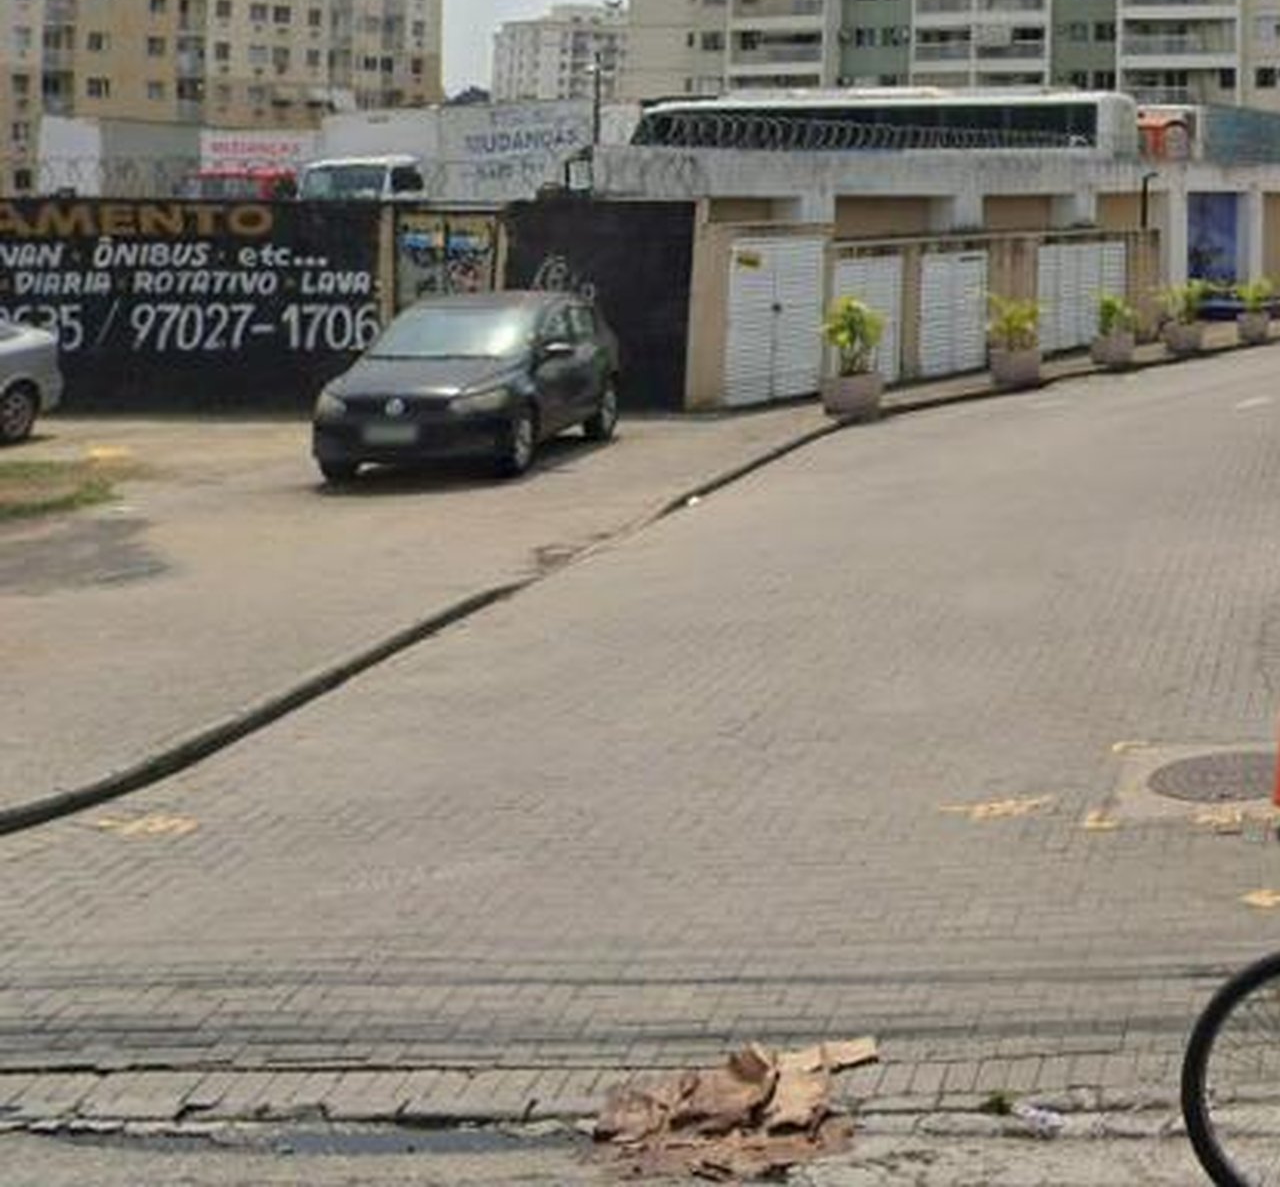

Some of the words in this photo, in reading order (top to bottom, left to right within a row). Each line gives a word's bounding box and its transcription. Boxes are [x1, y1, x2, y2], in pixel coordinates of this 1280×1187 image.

[0, 242, 63, 267] VAN
[15, 271, 112, 295] DIARIA
[132, 270, 278, 295] ROTATIVO
[130, 303, 380, 351] 97027-1706
